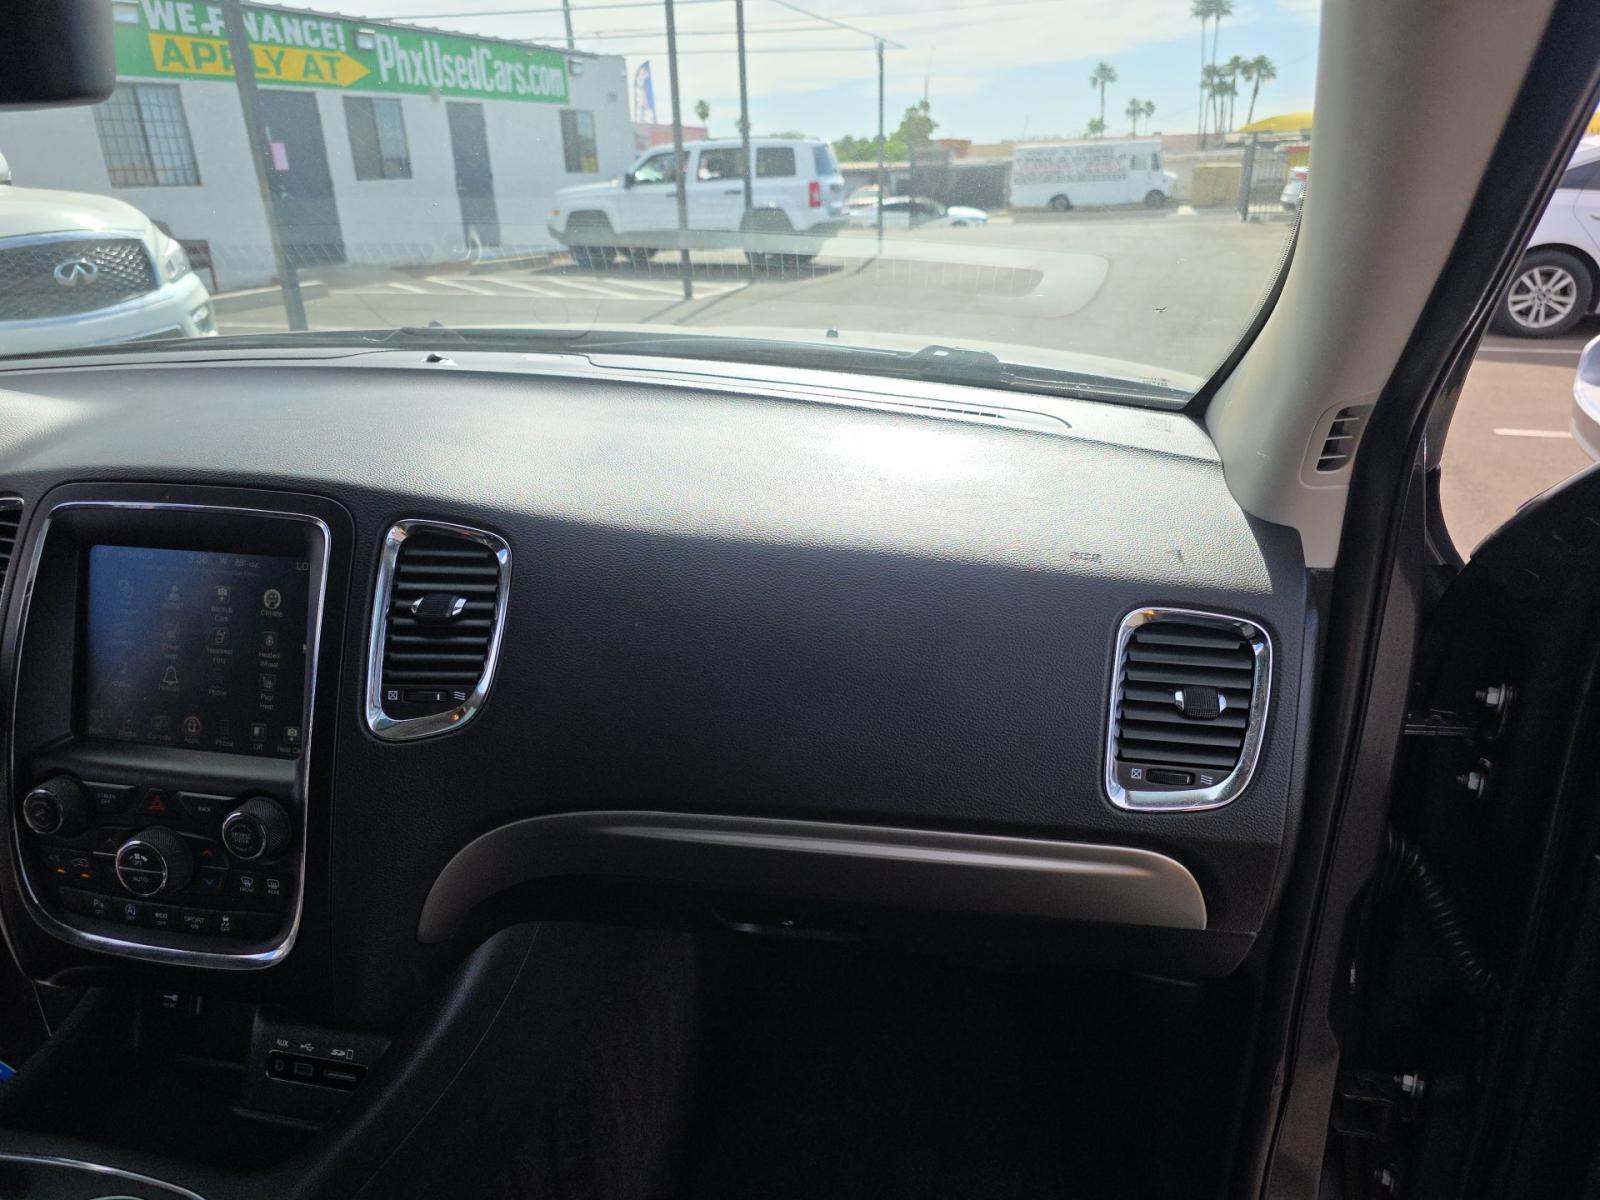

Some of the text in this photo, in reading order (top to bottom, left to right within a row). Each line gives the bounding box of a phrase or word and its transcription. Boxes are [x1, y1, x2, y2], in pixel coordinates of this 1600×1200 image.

[142, 0, 198, 35] WE
[303, 53, 342, 81] AT
[375, 34, 566, 98] PhxUsedCars.com
